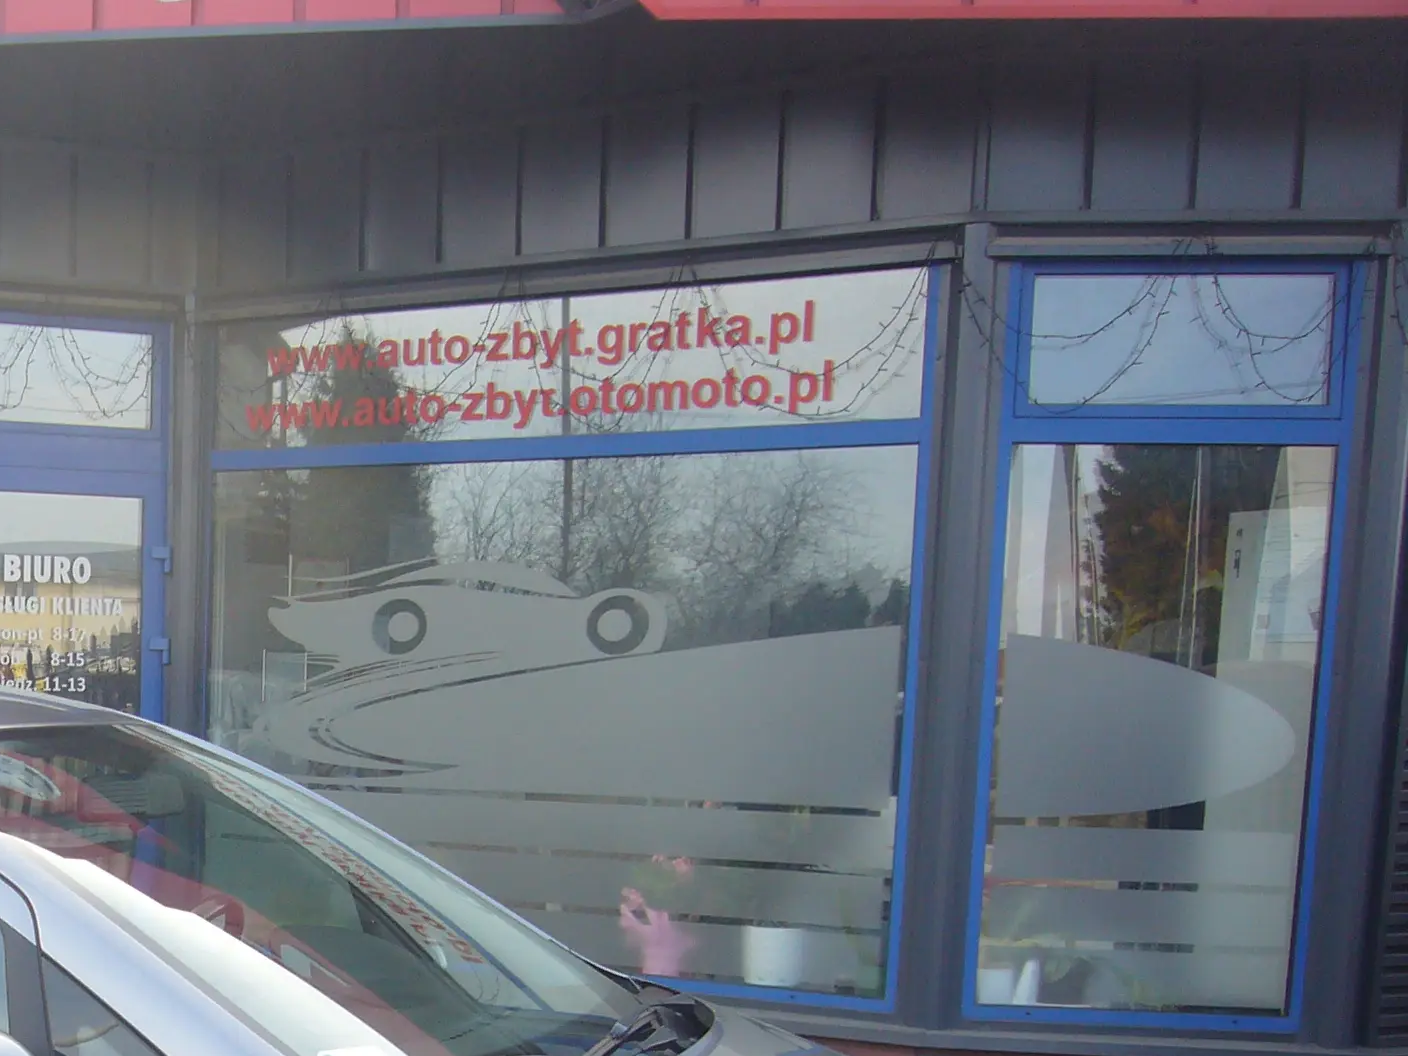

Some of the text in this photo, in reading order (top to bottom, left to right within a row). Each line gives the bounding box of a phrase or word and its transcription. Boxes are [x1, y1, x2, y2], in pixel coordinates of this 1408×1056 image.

[266, 300, 816, 376] www.auto-zbyt.gratka.pl
[244, 360, 837, 432] www.auto-zbyt.otomoto.pl
[3, 554, 92, 585] BIURO
[52, 598, 124, 617] KLIENTA
[52, 627, 86, 642] 8-17
[50, 652, 85, 667] 8-15
[43, 677, 86, 692] 11-13
